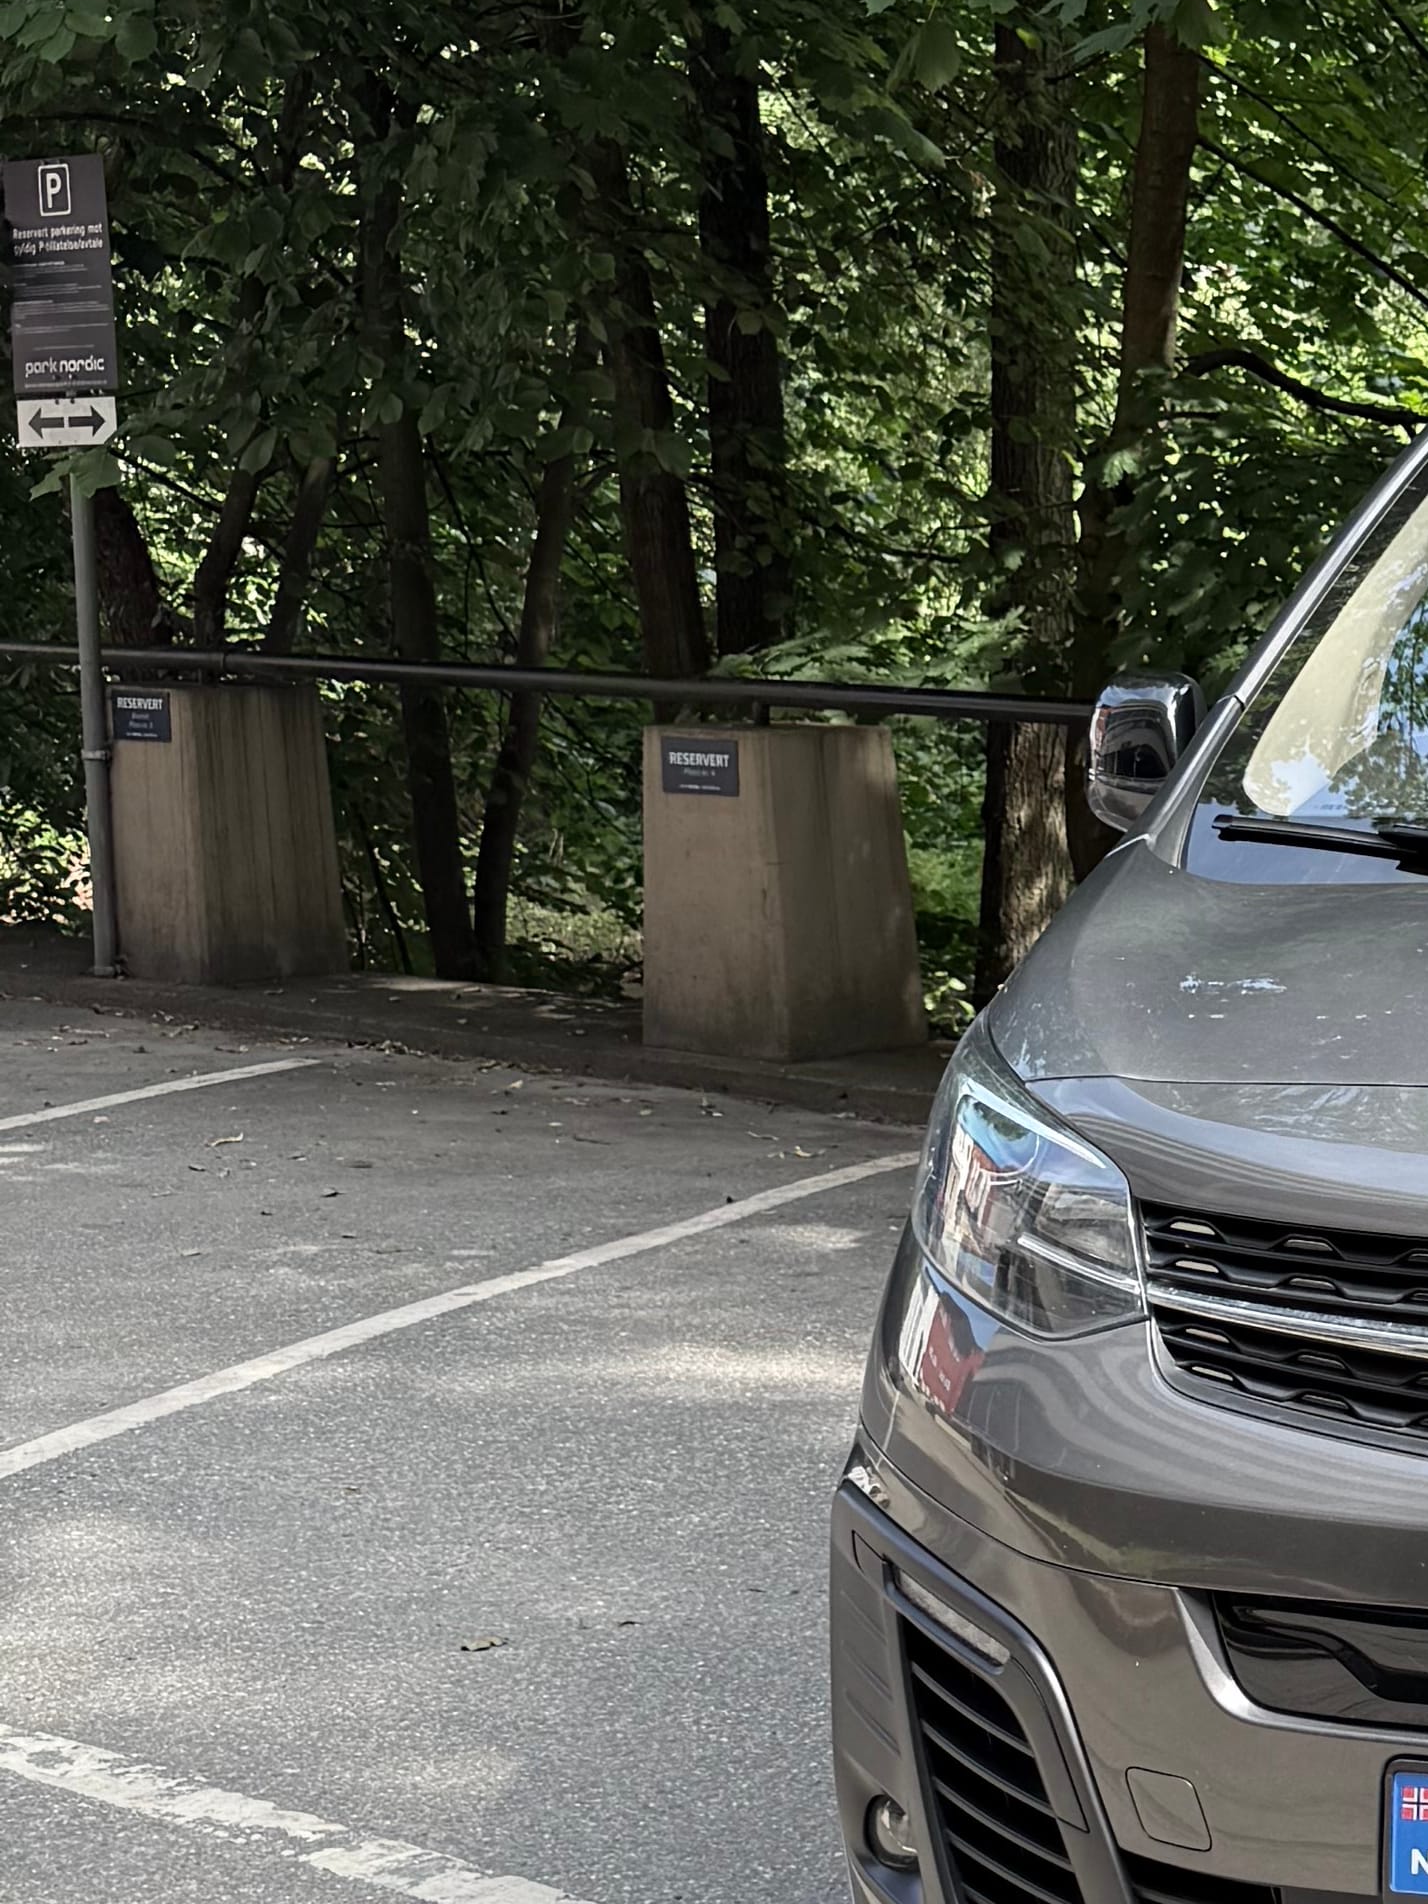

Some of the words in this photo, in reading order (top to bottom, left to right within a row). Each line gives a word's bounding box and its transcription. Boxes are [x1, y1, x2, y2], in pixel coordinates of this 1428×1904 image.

[46, 173, 61, 208] P
[13, 227, 48, 239] Reservert
[50, 225, 85, 238] parkering
[25, 356, 57, 378] park
[59, 355, 104, 372] nordic
[117, 697, 162, 710] RESERVERT
[669, 751, 729, 768] RESERVERT
